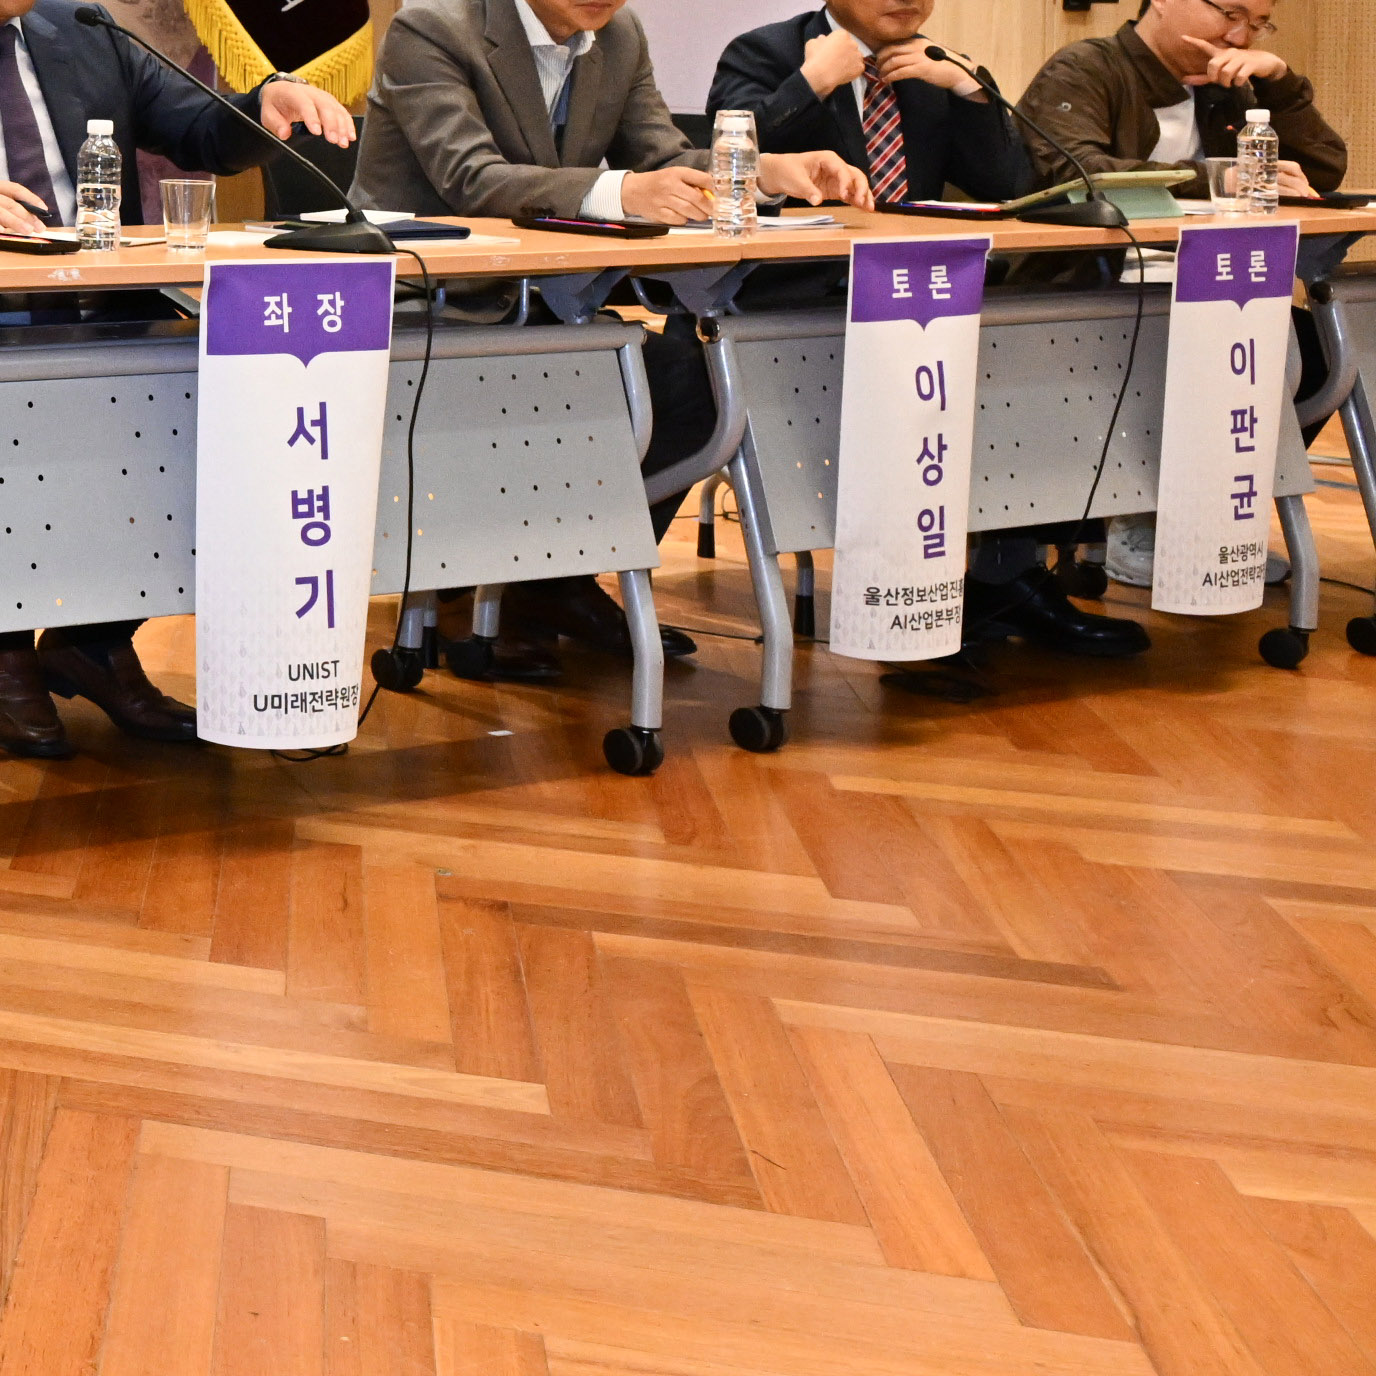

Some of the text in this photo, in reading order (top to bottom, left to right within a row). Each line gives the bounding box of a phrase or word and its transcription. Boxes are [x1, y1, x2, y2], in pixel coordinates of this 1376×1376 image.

[1230, 338, 1258, 521] 이판균
[915, 360, 948, 560] 이상일
[287, 402, 336, 628] 서병기
[1218, 540, 1264, 564] 울산광역시
[890, 605, 961, 632] AI산업본부장
[288, 660, 340, 682] UNIST
[253, 685, 358, 716] U미래전략원장
